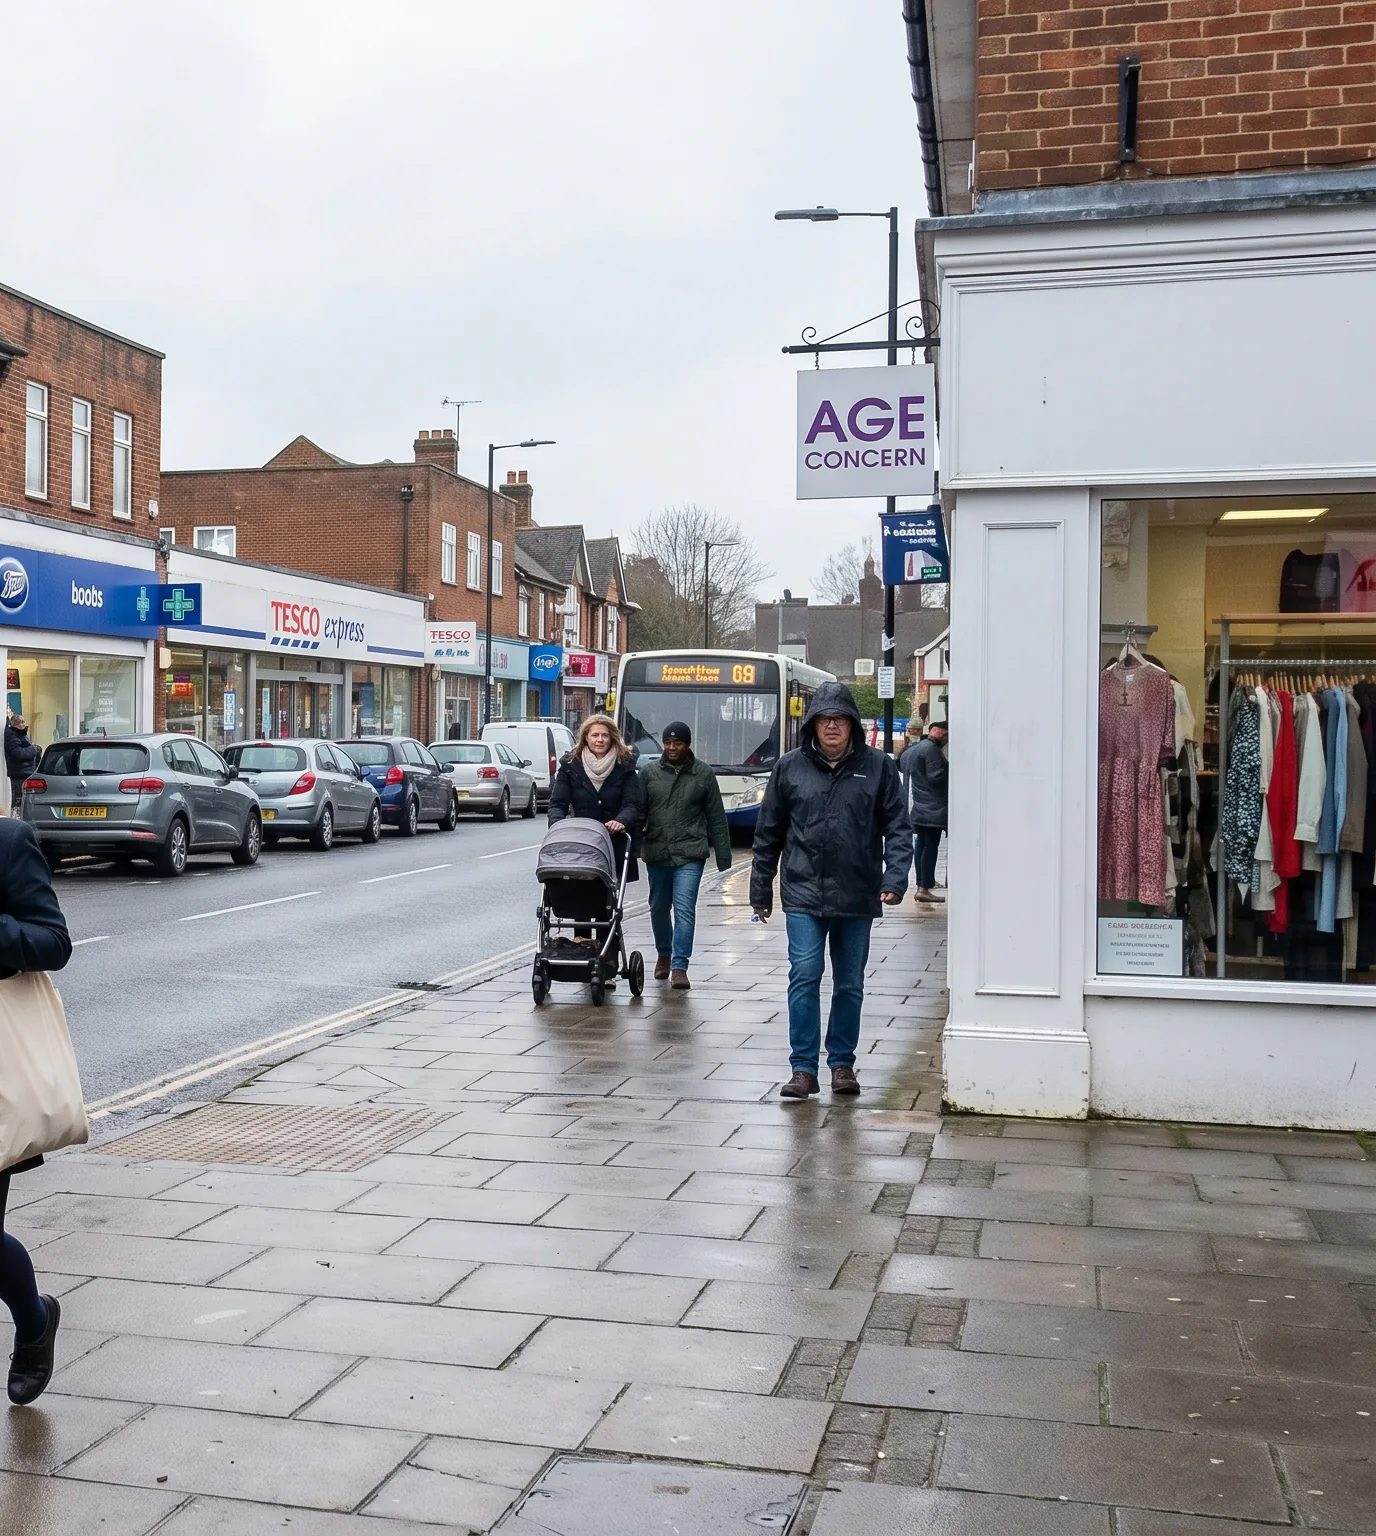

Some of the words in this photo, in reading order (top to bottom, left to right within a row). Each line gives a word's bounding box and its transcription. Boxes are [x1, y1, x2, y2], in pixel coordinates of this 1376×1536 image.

[804, 396, 925, 444] AGE
[804, 447, 926, 470] CONCERN
[71, 579, 103, 608] boobs
[271, 601, 320, 637] TESCO
[324, 616, 364, 649] express
[430, 630, 471, 640] TESCO
